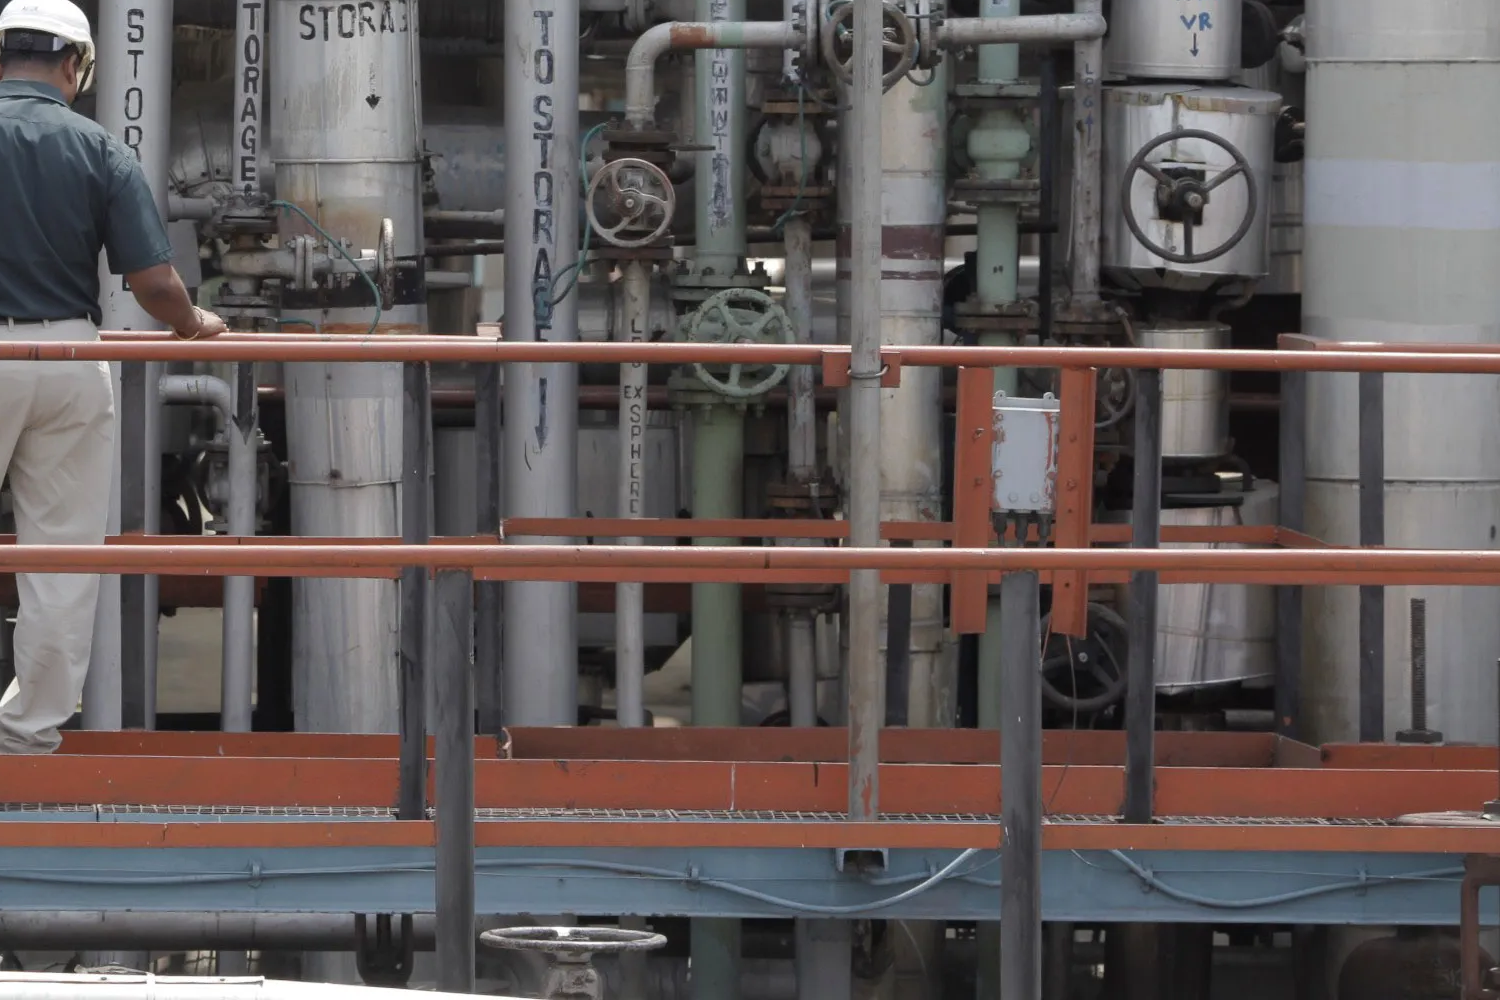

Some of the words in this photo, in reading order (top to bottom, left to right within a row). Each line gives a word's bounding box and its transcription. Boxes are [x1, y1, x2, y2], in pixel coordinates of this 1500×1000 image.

[299, 0, 418, 41] STORA
[1180, 11, 1213, 32] VR
[533, 10, 554, 84] TO
[623, 385, 644, 400] EX
[629, 404, 643, 514] SPHERE
